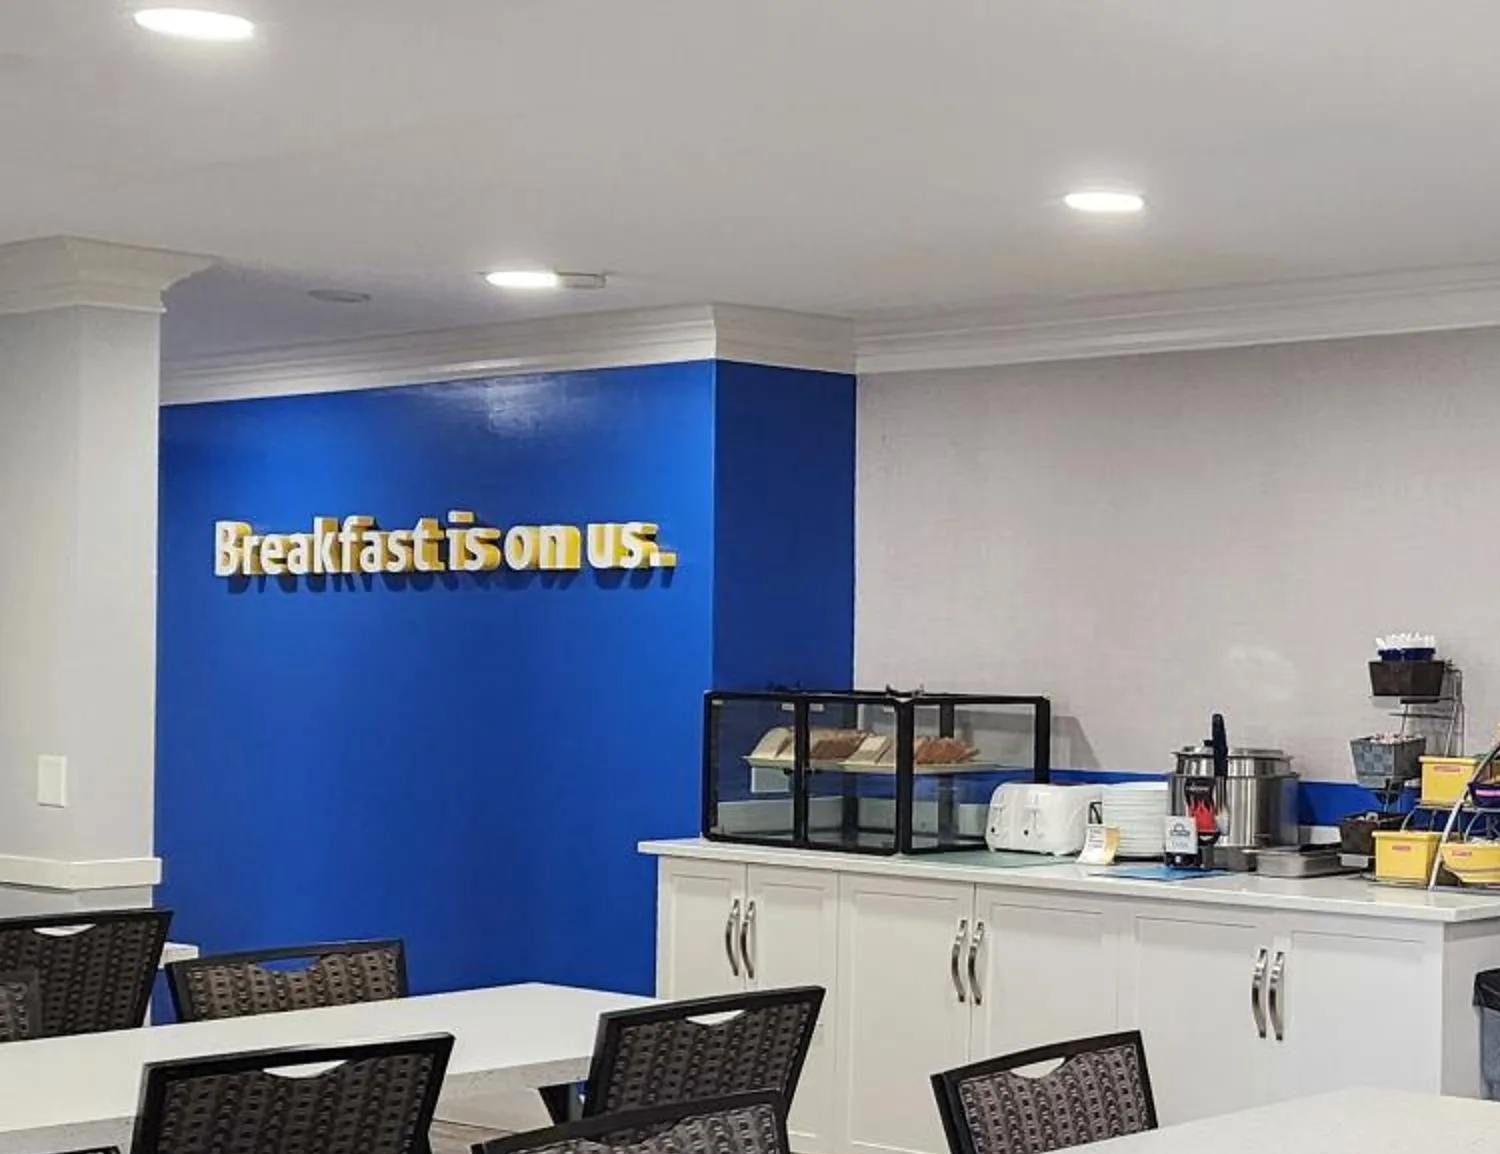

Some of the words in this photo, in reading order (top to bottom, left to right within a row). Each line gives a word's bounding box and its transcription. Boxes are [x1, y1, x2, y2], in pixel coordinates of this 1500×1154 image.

[214, 514, 446, 577] Breakfast
[445, 510, 502, 572] is
[504, 523, 582, 571] on
[586, 521, 678, 570] us.
